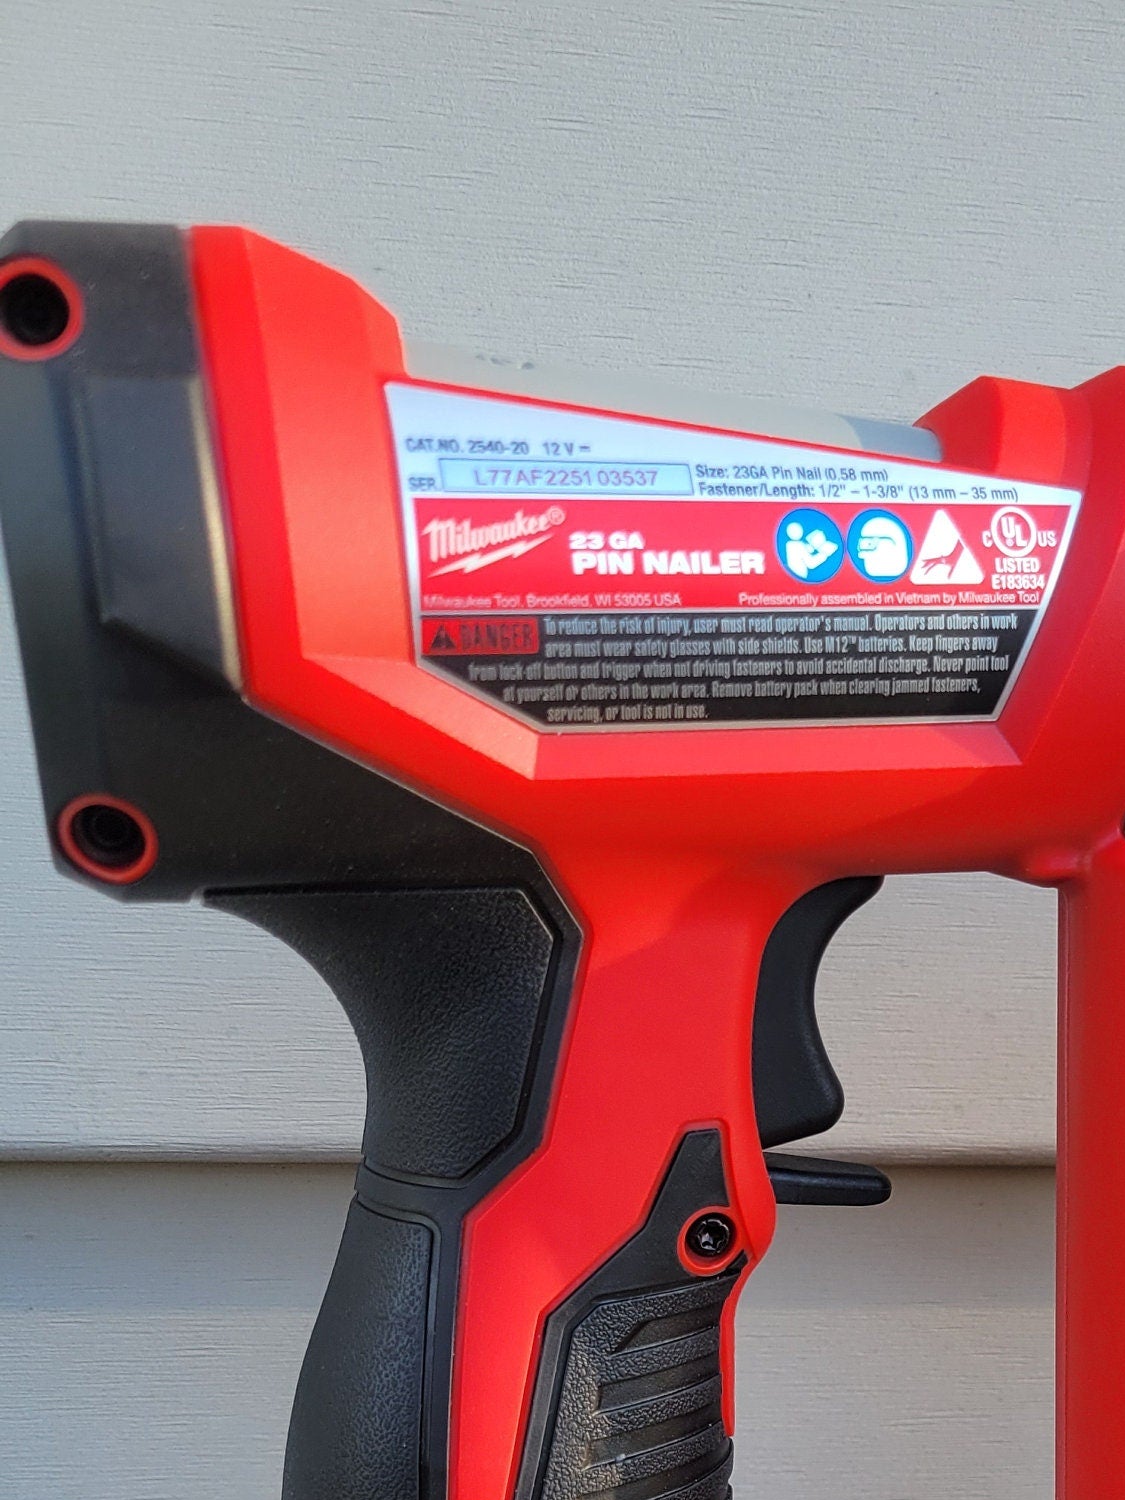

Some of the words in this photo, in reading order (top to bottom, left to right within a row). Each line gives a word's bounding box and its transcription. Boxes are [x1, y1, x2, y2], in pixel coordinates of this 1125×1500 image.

[468, 440, 530, 455] 2540-20
[543, 442, 561, 456] 12
[563, 442, 574, 456] V
[695, 464, 730, 478] Size:
[733, 465, 769, 479] 23GA
[771, 466, 793, 480] Pin
[796, 466, 822, 481] Nail
[825, 467, 858, 482] (0.58
[860, 469, 889, 482] mm)
[698, 481, 816, 500] Fastener/Length:
[818, 484, 846, 498] 1/2"
[863, 485, 904, 499] 1-3/8"
[909, 485, 929, 501] (13
[932, 488, 957, 499] mm
[971, 487, 987, 500] 35
[991, 488, 1019, 502] mm)
[569, 532, 603, 549] 23
[608, 532, 644, 549] GA
[571, 552, 634, 575] PIN
[643, 551, 765, 575] NAILER
[995, 557, 1040, 573] LISTED
[991, 574, 1045, 590] E183634
[595, 593, 611, 606] WI
[615, 593, 651, 606] 53005
[654, 593, 682, 606] USA
[738, 593, 818, 607] Professionally
[821, 592, 883, 605] assembled
[884, 592, 894, 605] in
[895, 592, 941, 605] Vietnam
[943, 592, 957, 607] by
[959, 591, 1016, 604] Milwaukee
[1017, 590, 1040, 604] Tool
[544, 617, 556, 635] To
[558, 617, 598, 634] reduce
[600, 617, 617, 634] the
[619, 617, 642, 634] risk
[644, 617, 655, 634] of
[656, 617, 692, 637] injury,
[693, 618, 718, 633] user
[721, 617, 746, 633] must
[749, 616, 773, 633] read
[775, 616, 831, 635] operator's
[834, 615, 873, 632] manual.
[874, 614, 926, 634] Operators
[927, 614, 945, 630] and
[946, 613, 979, 630] others
[980, 613, 990, 630] in
[991, 613, 1018, 630] work
[460, 623, 533, 650] DANGER
[545, 642, 572, 657] area
[574, 641, 601, 657] must
[603, 641, 632, 656] wear
[634, 639, 667, 658] safety
[670, 638, 711, 658] glasses
[713, 638, 736, 655] with
[738, 637, 760, 655] side
[762, 637, 802, 654] shields.
[804, 636, 823, 654] Use
[858, 635, 907, 652] batteries.
[909, 635, 933, 654] Keep
[935, 635, 970, 653] fingers
[972, 636, 999, 653] away
[543, 661, 578, 680] button
[580, 661, 600, 679] and
[602, 660, 641, 681] trigger
[643, 659, 672, 678] when
[674, 660, 691, 677] not
[693, 659, 731, 678] driving
[733, 659, 782, 676] fasteners
[784, 659, 794, 675] to
[796, 658, 824, 675] avoid
[825, 656, 877, 674] accidental
[878, 656, 931, 675] discharge.
[933, 655, 964, 672] Never
[965, 655, 989, 674] point
[990, 655, 1010, 671] tool
[503, 684, 515, 701] at
[517, 683, 564, 704] yourself
[565, 685, 578, 700] or
[581, 683, 617, 700] others
[619, 682, 629, 699] in
[631, 682, 648, 699] the
[650, 681, 679, 699] work
[681, 682, 710, 698] area.
[712, 680, 753, 698] Remove
[755, 680, 792, 699] battery
[794, 680, 818, 698] pack
[820, 679, 847, 696] when
[849, 677, 889, 696] clearing
[891, 677, 930, 696] jammed
[931, 676, 981, 694] fasteners,
[547, 705, 602, 723] servicing,
[604, 706, 618, 720] or
[621, 705, 641, 720] tool
[643, 704, 653, 719] is
[655, 704, 672, 719] not
[674, 704, 684, 718] in
[686, 704, 709, 719] use.
